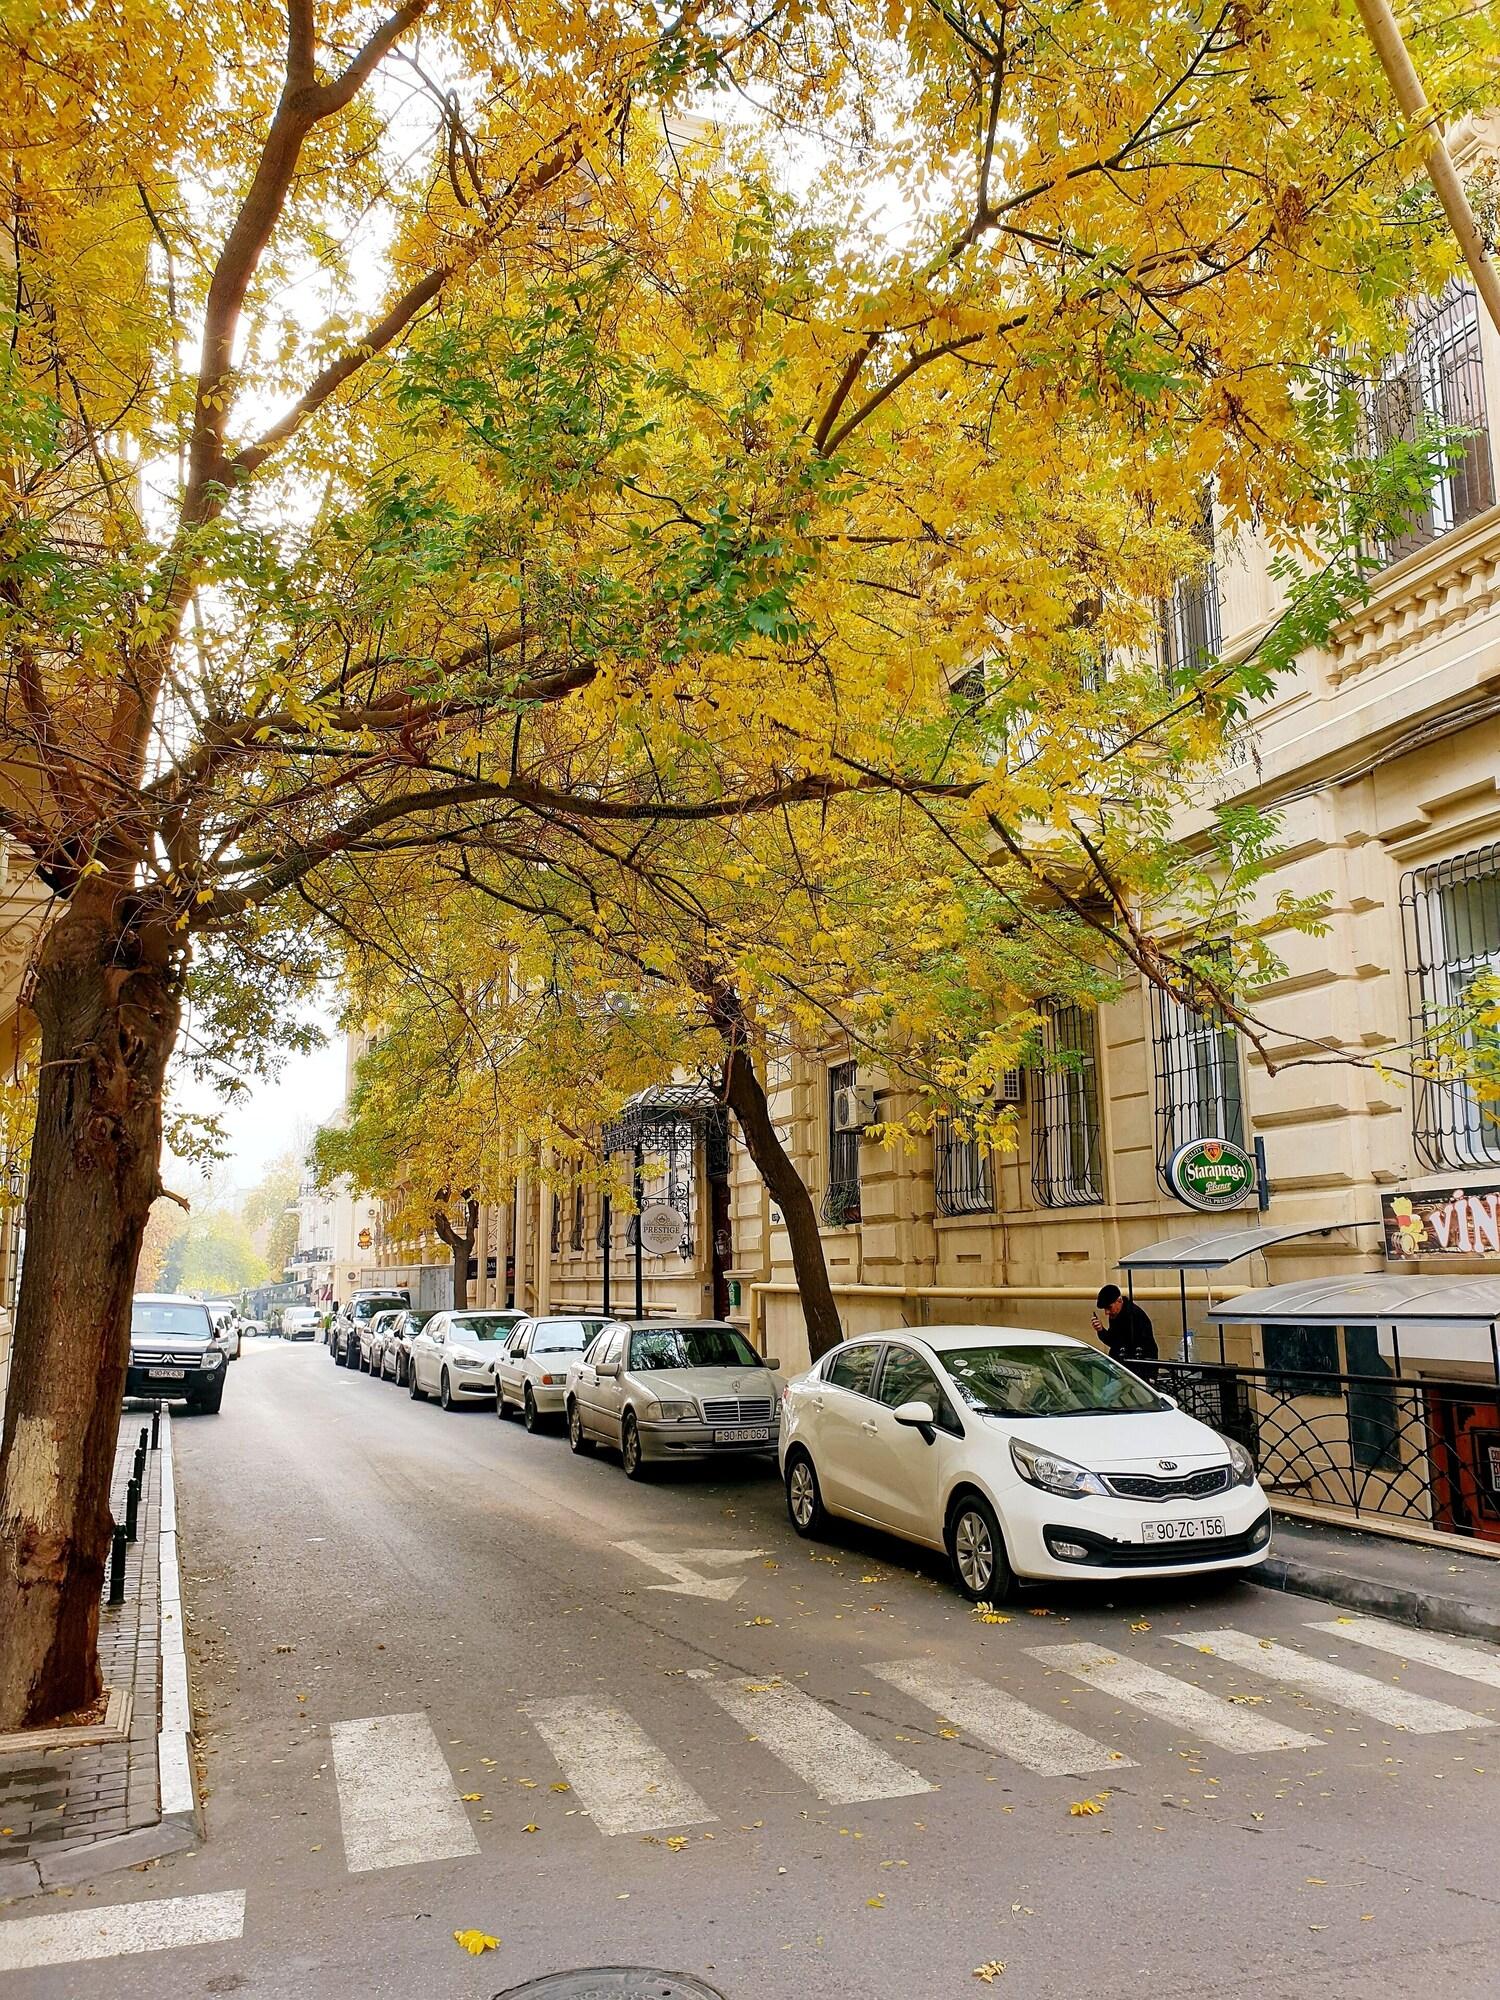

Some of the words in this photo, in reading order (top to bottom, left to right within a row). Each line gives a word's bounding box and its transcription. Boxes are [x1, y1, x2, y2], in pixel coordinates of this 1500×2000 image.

[1187, 1162, 1245, 1182] Starapraga
[643, 1226, 680, 1234] PRESTIGE
[1159, 1461, 1177, 1470] KIA
